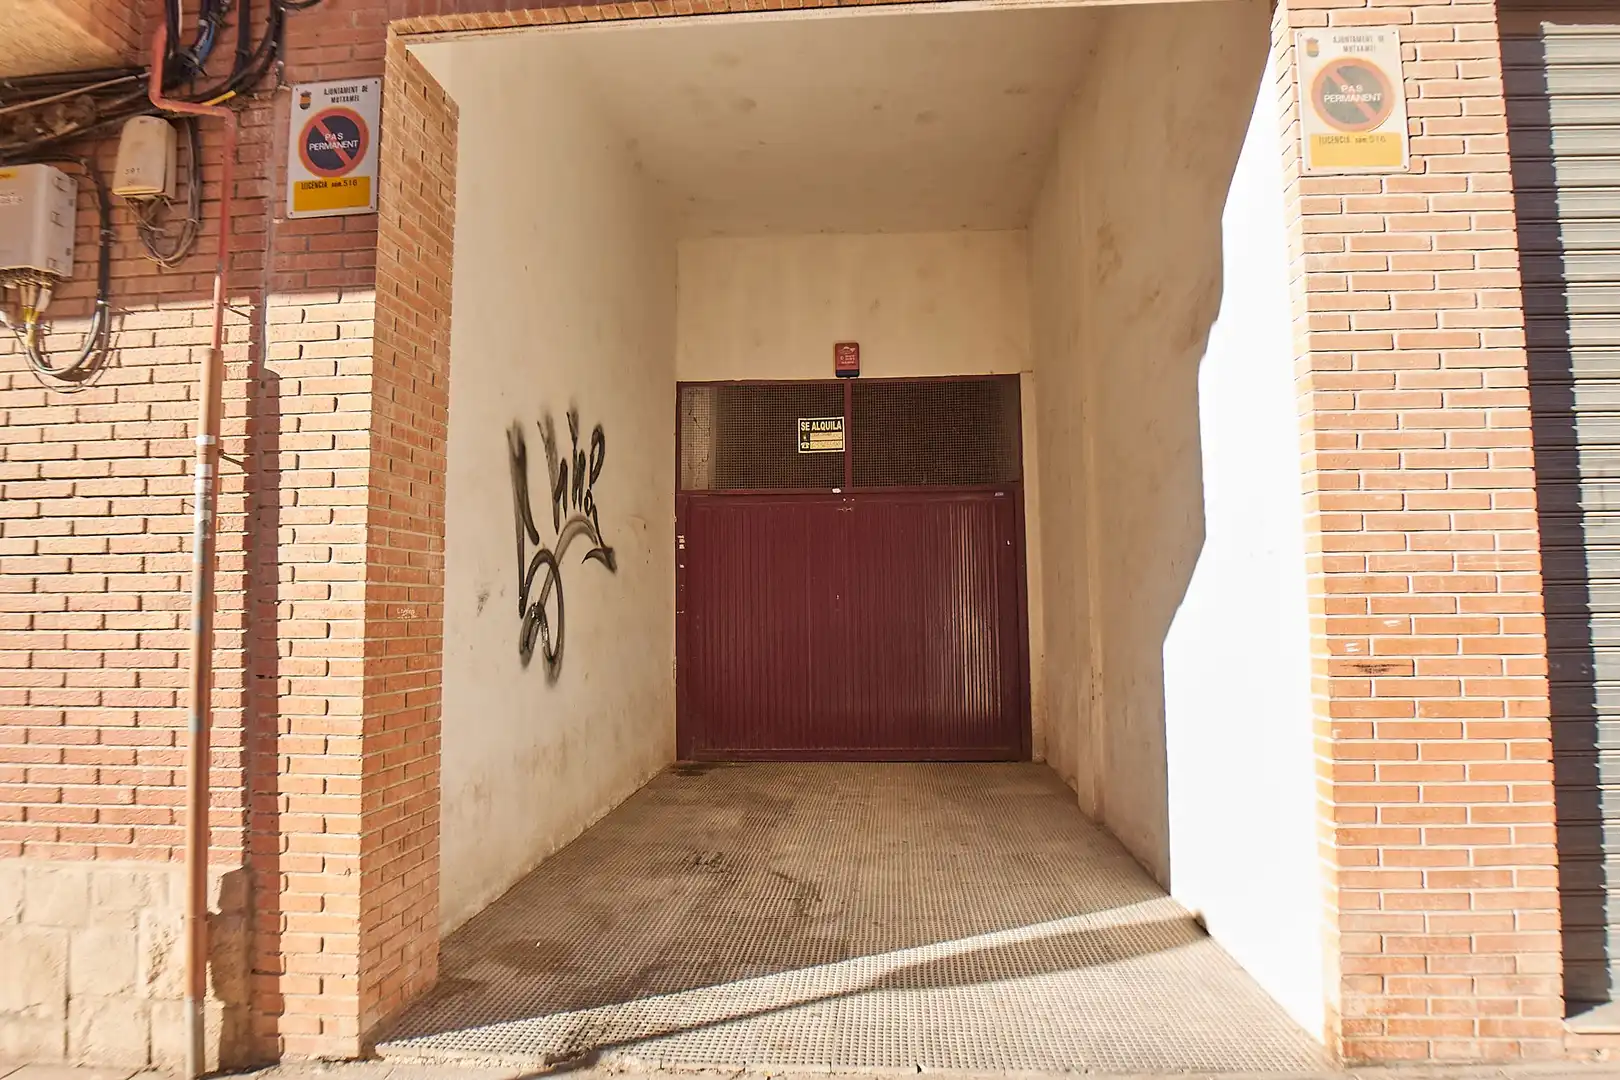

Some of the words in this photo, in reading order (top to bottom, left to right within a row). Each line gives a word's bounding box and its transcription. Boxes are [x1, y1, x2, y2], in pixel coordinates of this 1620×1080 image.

[1341, 84, 1363, 93] PAS
[1323, 93, 1382, 103] PERMANENT
[324, 132, 344, 141] PAS
[309, 139, 359, 151] PERMANENT
[801, 422, 810, 431] SE
[811, 420, 842, 431] ALQUILA
